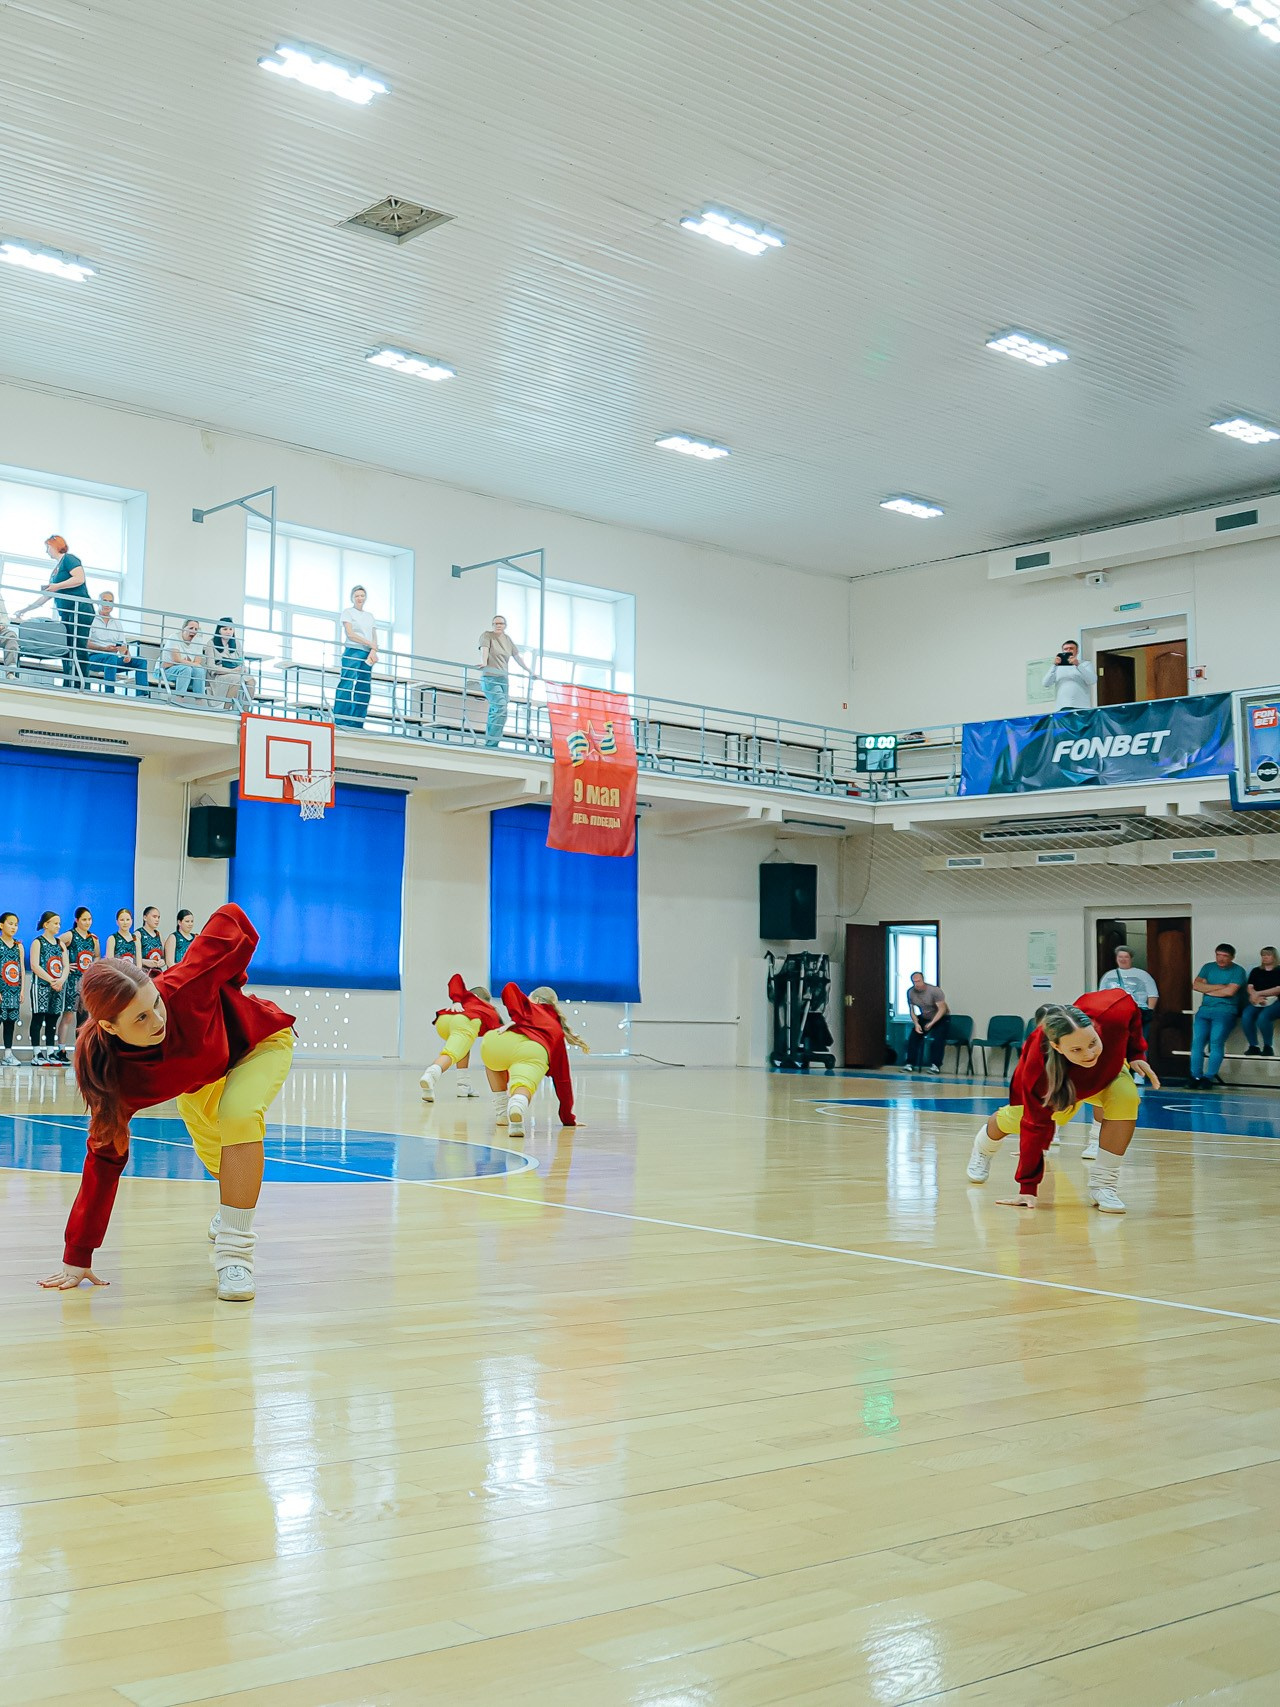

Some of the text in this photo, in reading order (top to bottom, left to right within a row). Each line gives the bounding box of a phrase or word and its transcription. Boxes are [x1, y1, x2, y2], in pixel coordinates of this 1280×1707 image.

[1254, 709, 1275, 719] FON
[1254, 717, 1276, 727] BET
[1052, 730, 1171, 763] FONBET
[573, 778, 583, 803] 9
